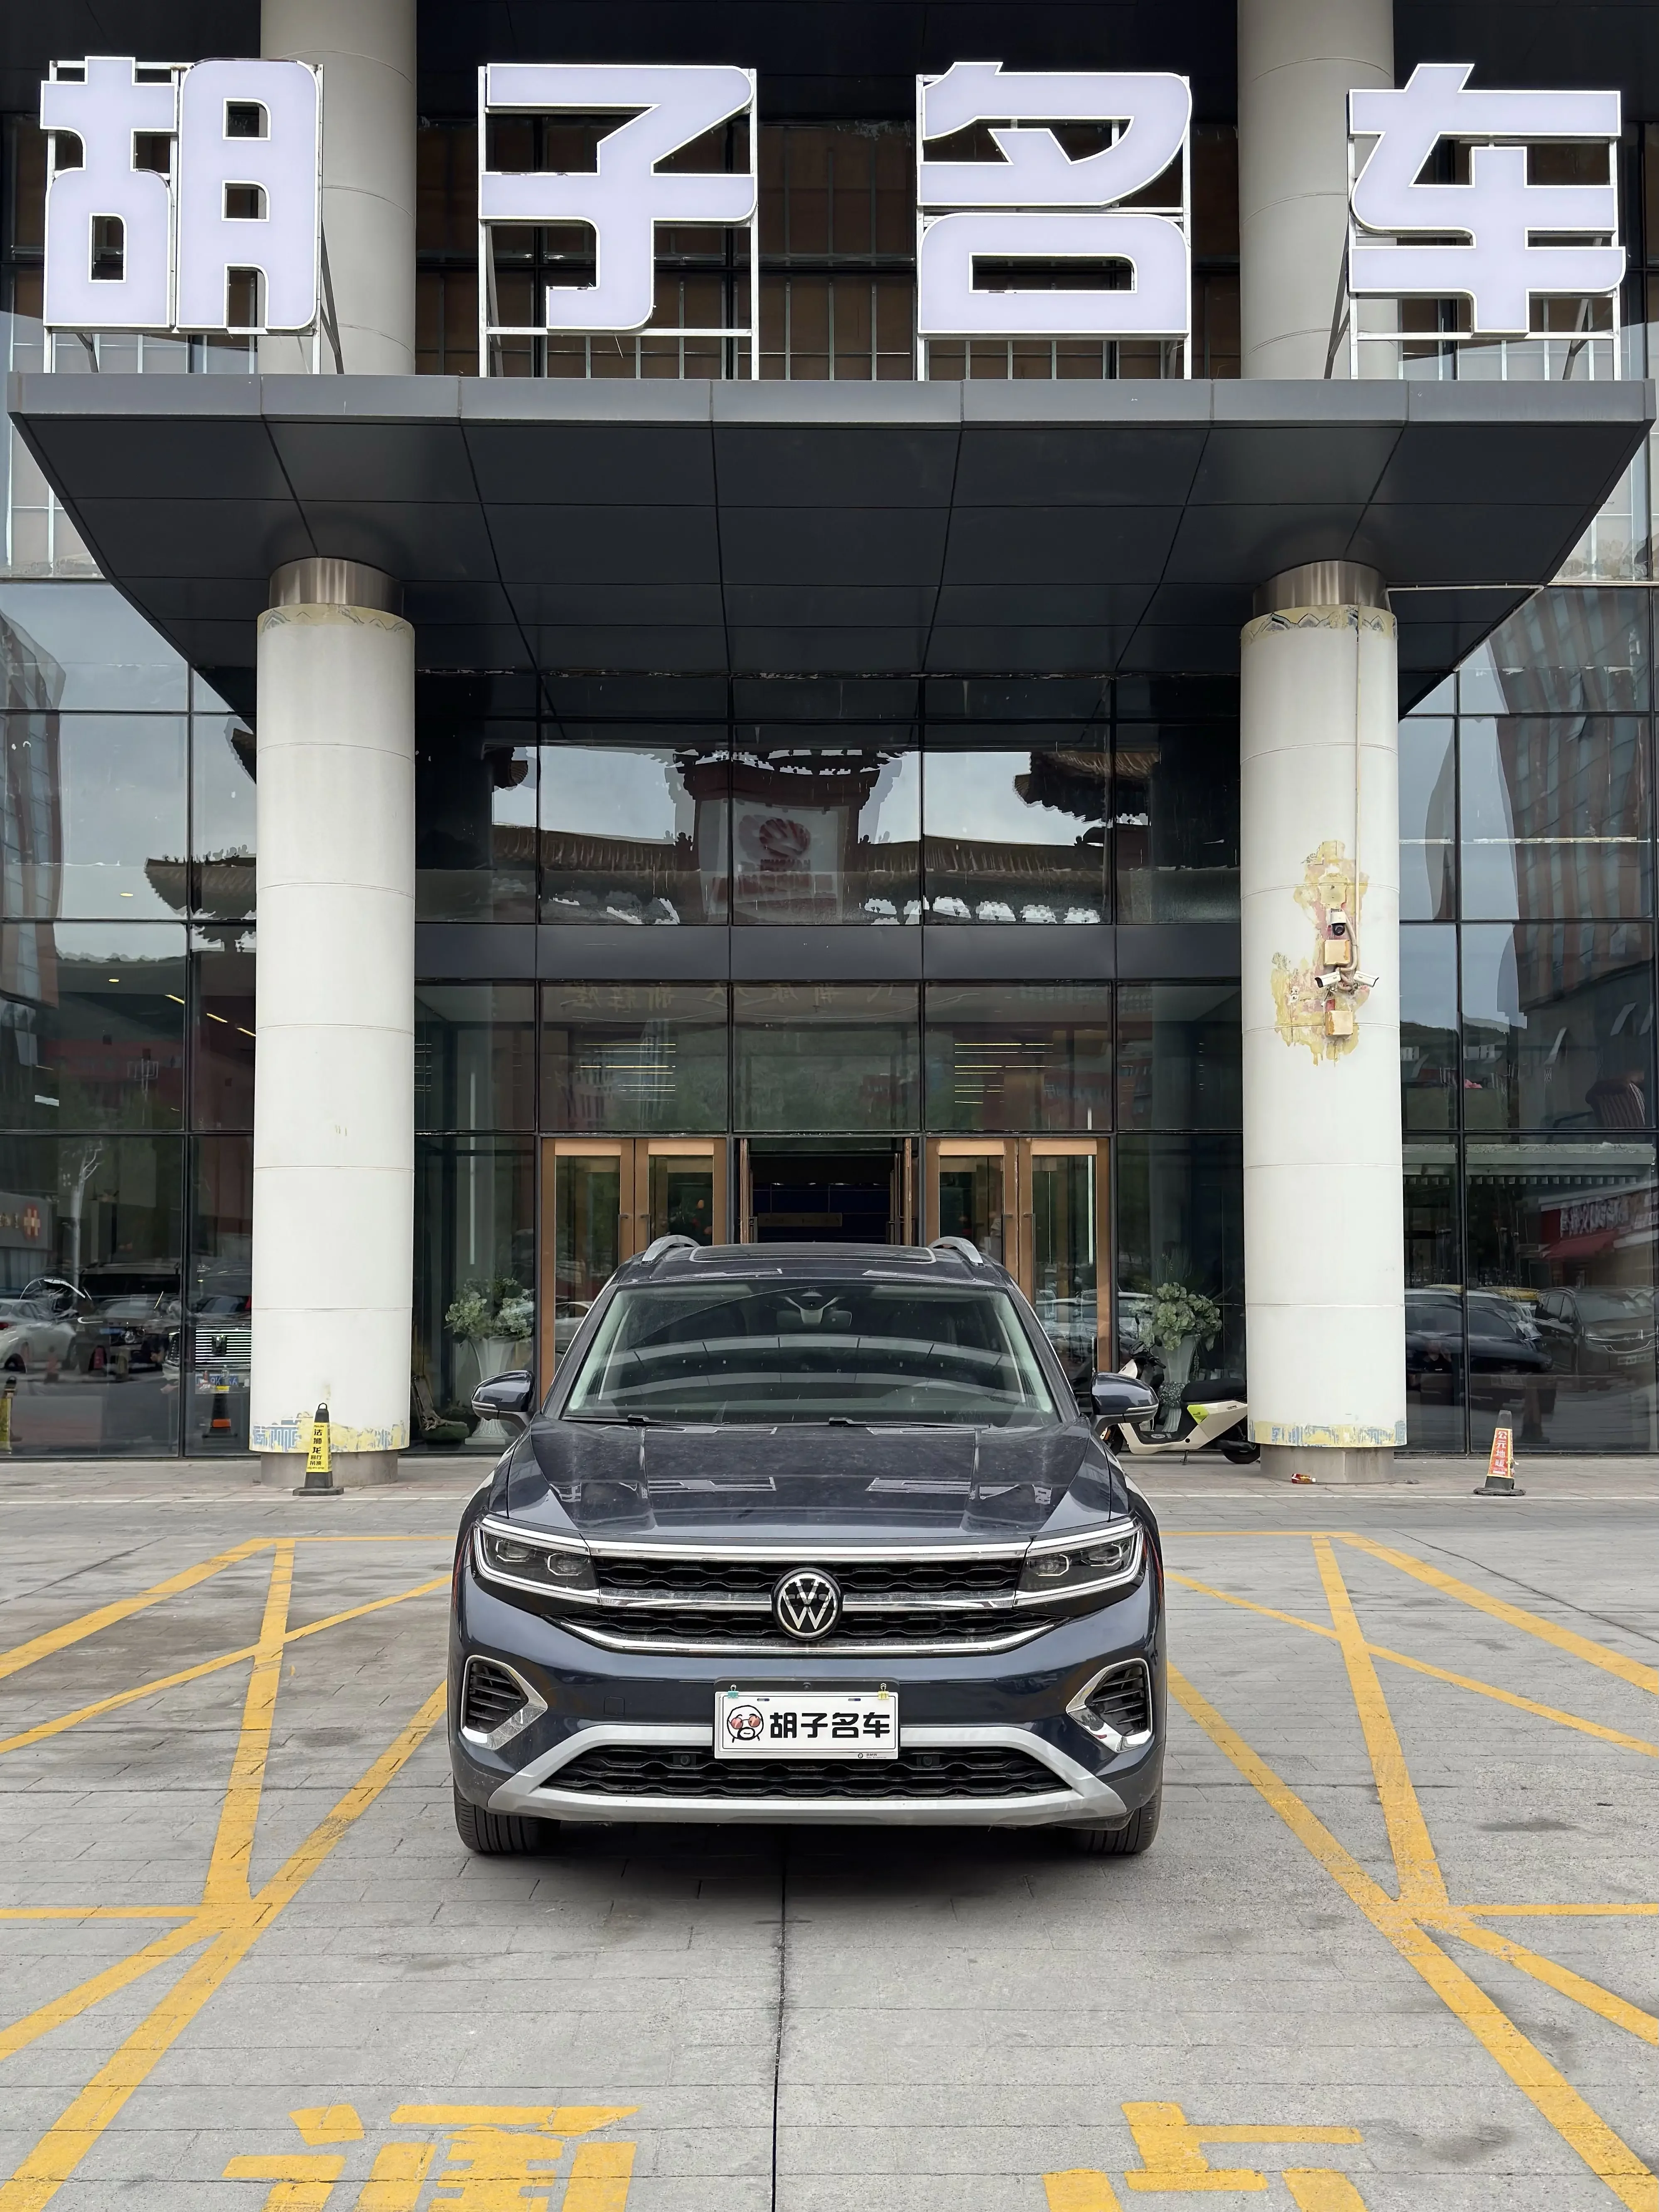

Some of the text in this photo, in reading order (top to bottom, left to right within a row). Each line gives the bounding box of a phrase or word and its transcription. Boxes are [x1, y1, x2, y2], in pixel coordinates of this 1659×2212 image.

[40, 55, 1626, 335] 胡子名车
[313, 1429, 322, 1453] 法狮龙
[769, 1712, 890, 1738] 胡子名车
